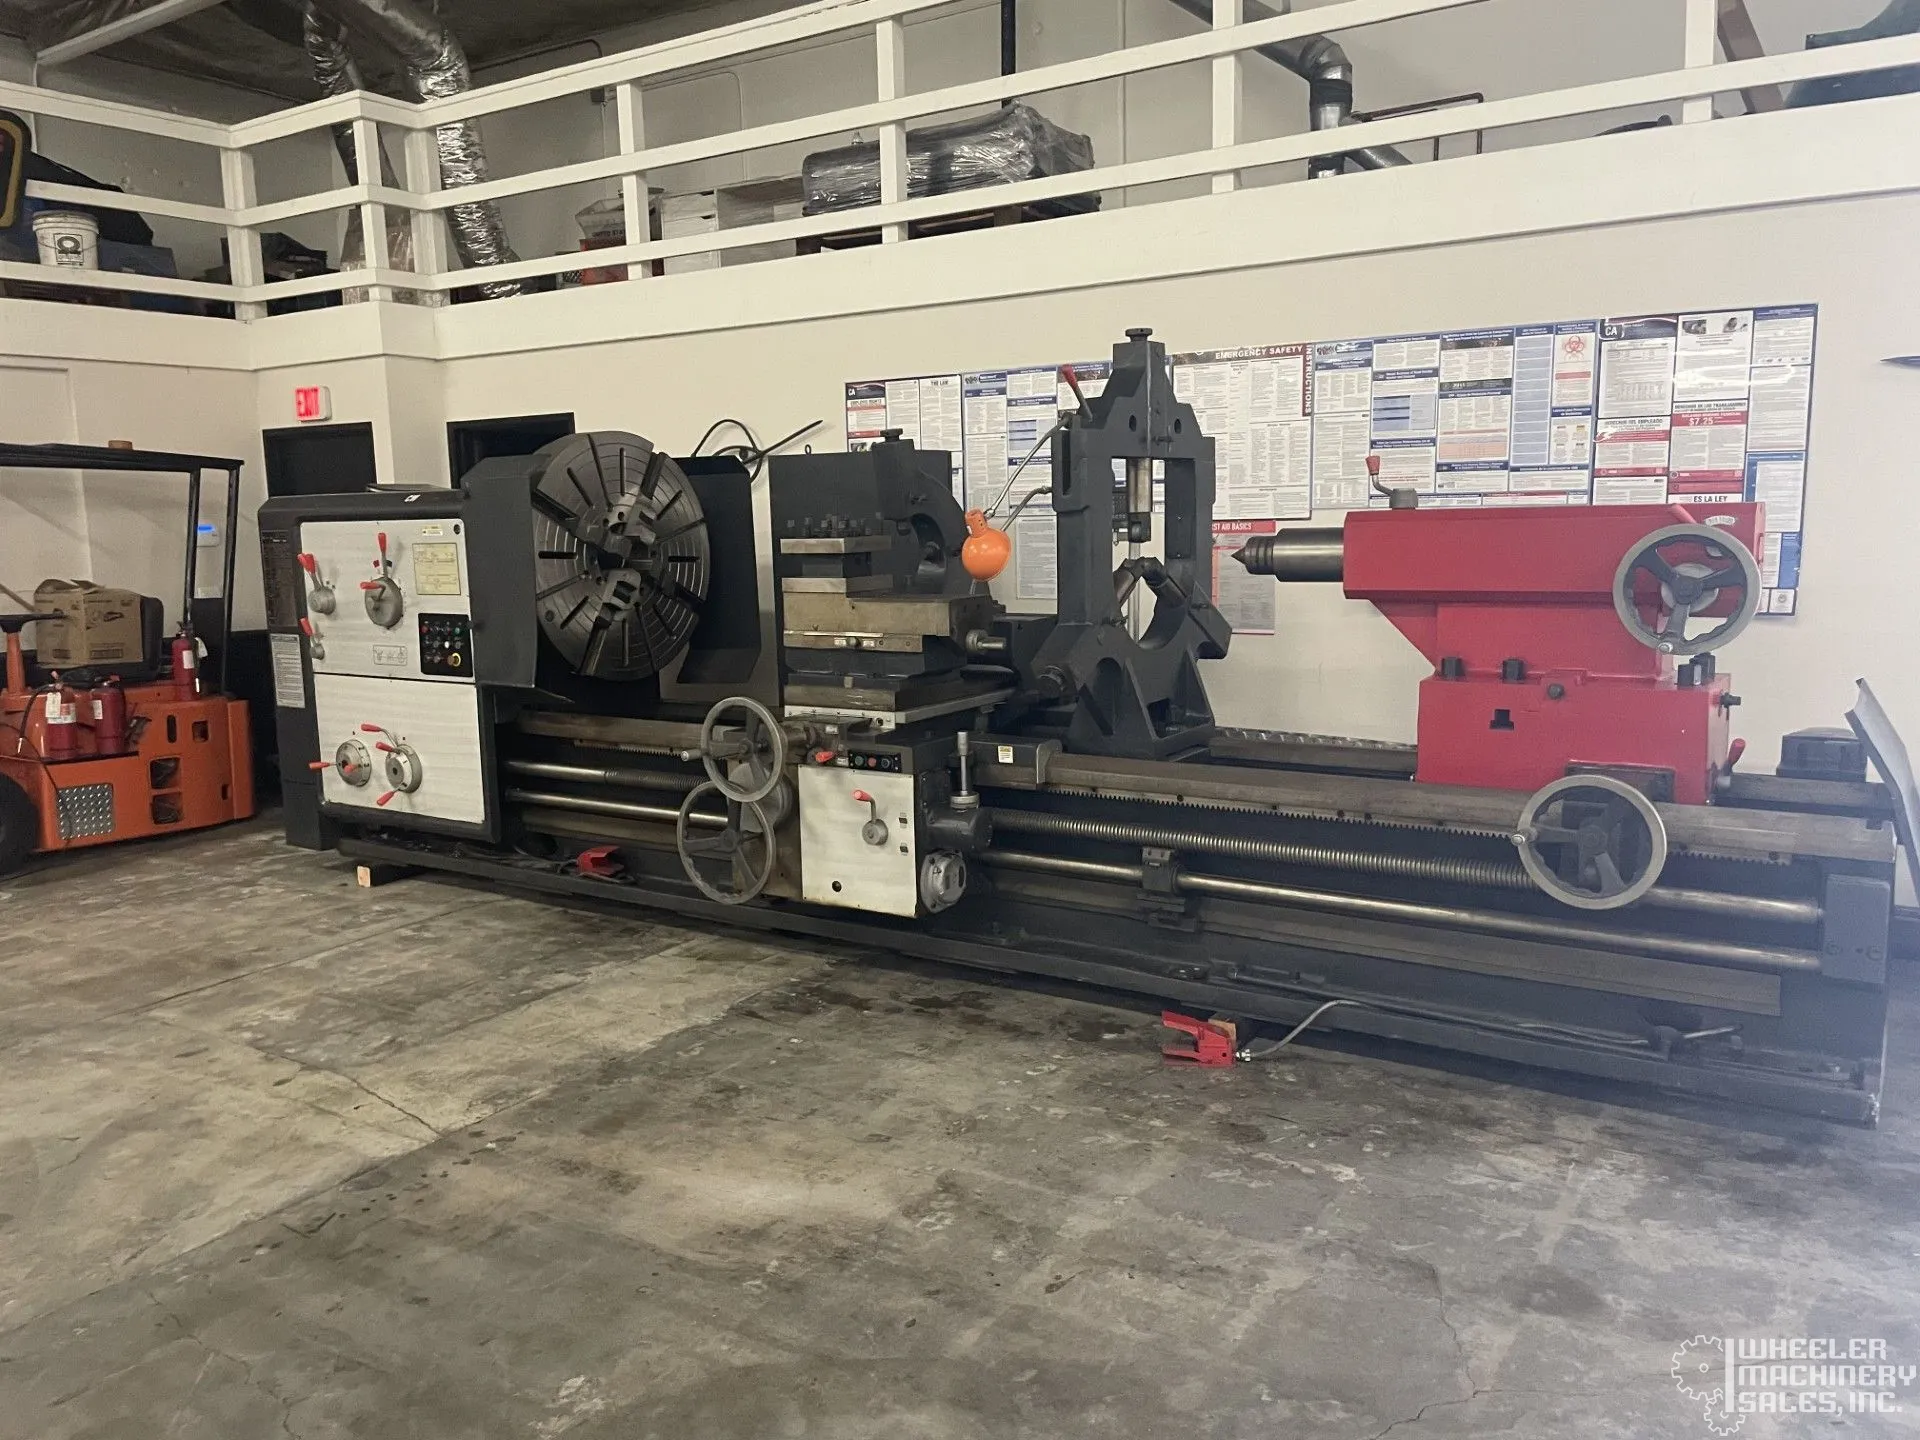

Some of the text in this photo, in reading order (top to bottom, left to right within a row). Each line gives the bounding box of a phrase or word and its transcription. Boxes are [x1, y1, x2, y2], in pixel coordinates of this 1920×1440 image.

[1604, 326, 1618, 336] CA
[1215, 348, 1267, 360] EMERGENCY
[1269, 345, 1303, 355] SAFETY
[1305, 344, 1313, 414] INSTRUCTIONS
[1689, 416, 1714, 425] $7.25
[1231, 522, 1252, 531] BASICS
